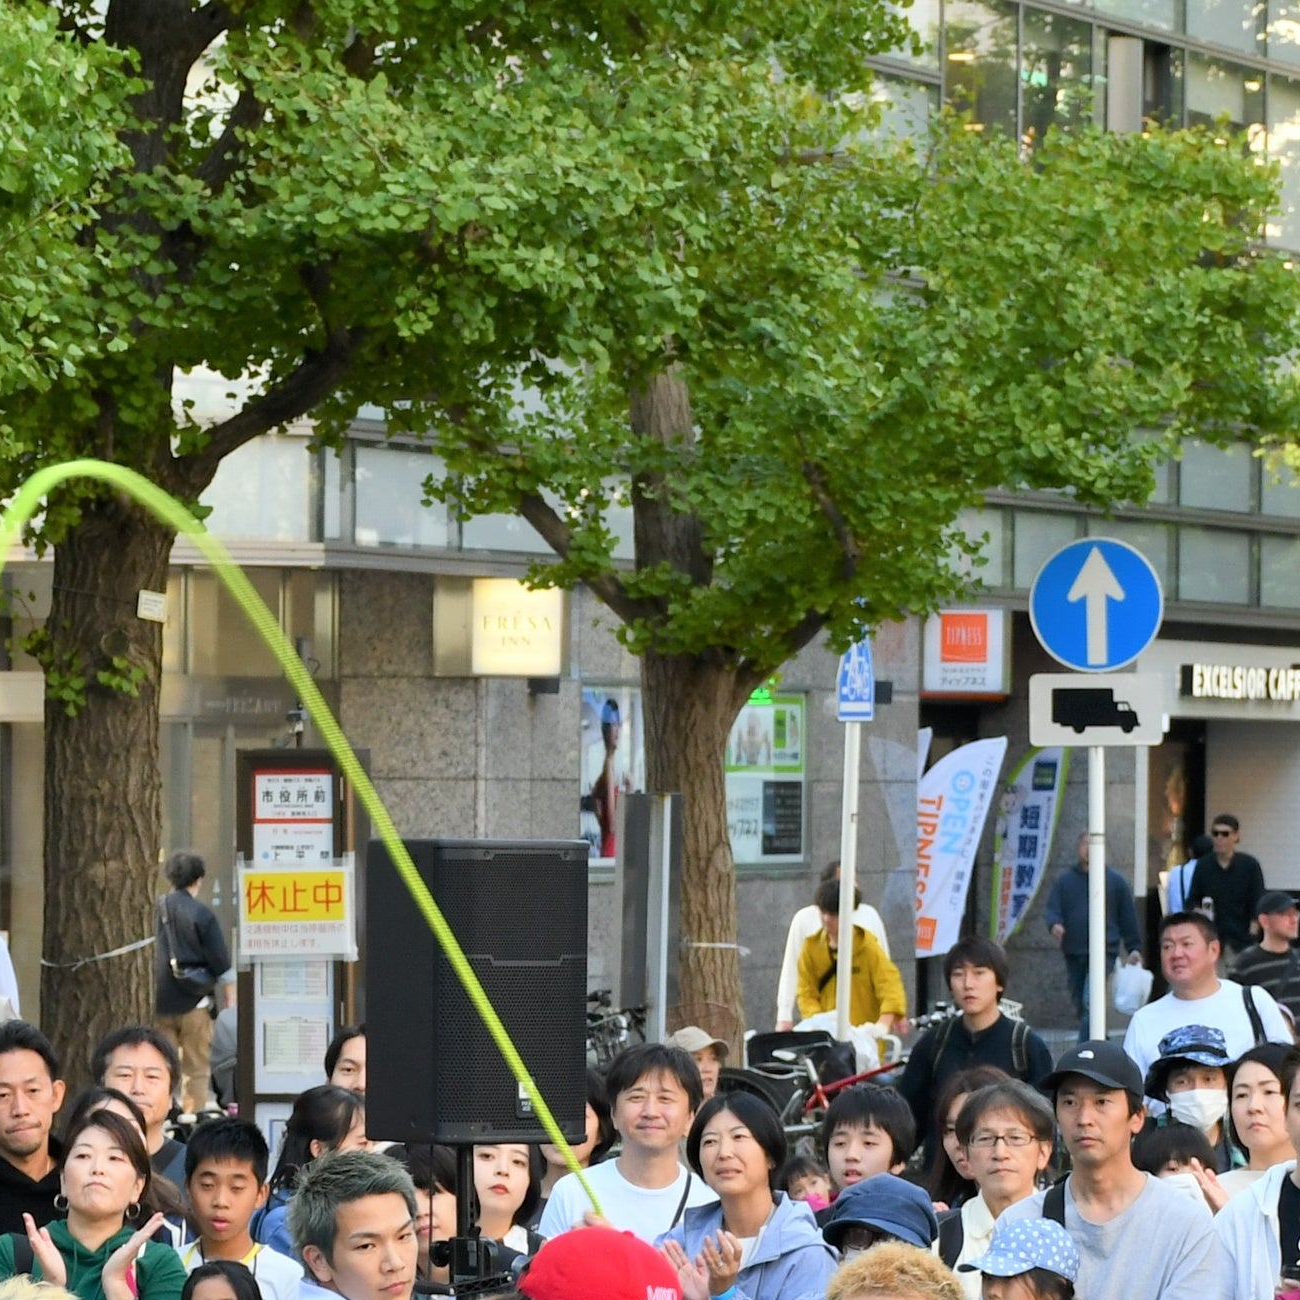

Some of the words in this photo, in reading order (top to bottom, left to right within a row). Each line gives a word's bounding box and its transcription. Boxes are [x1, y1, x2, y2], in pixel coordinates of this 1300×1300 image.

[1192, 663, 1267, 700] EXCELSIOR
[262, 788, 326, 804] 市役所前
[941, 769, 976, 855] OPEN
[246, 879, 343, 915] 休止中
